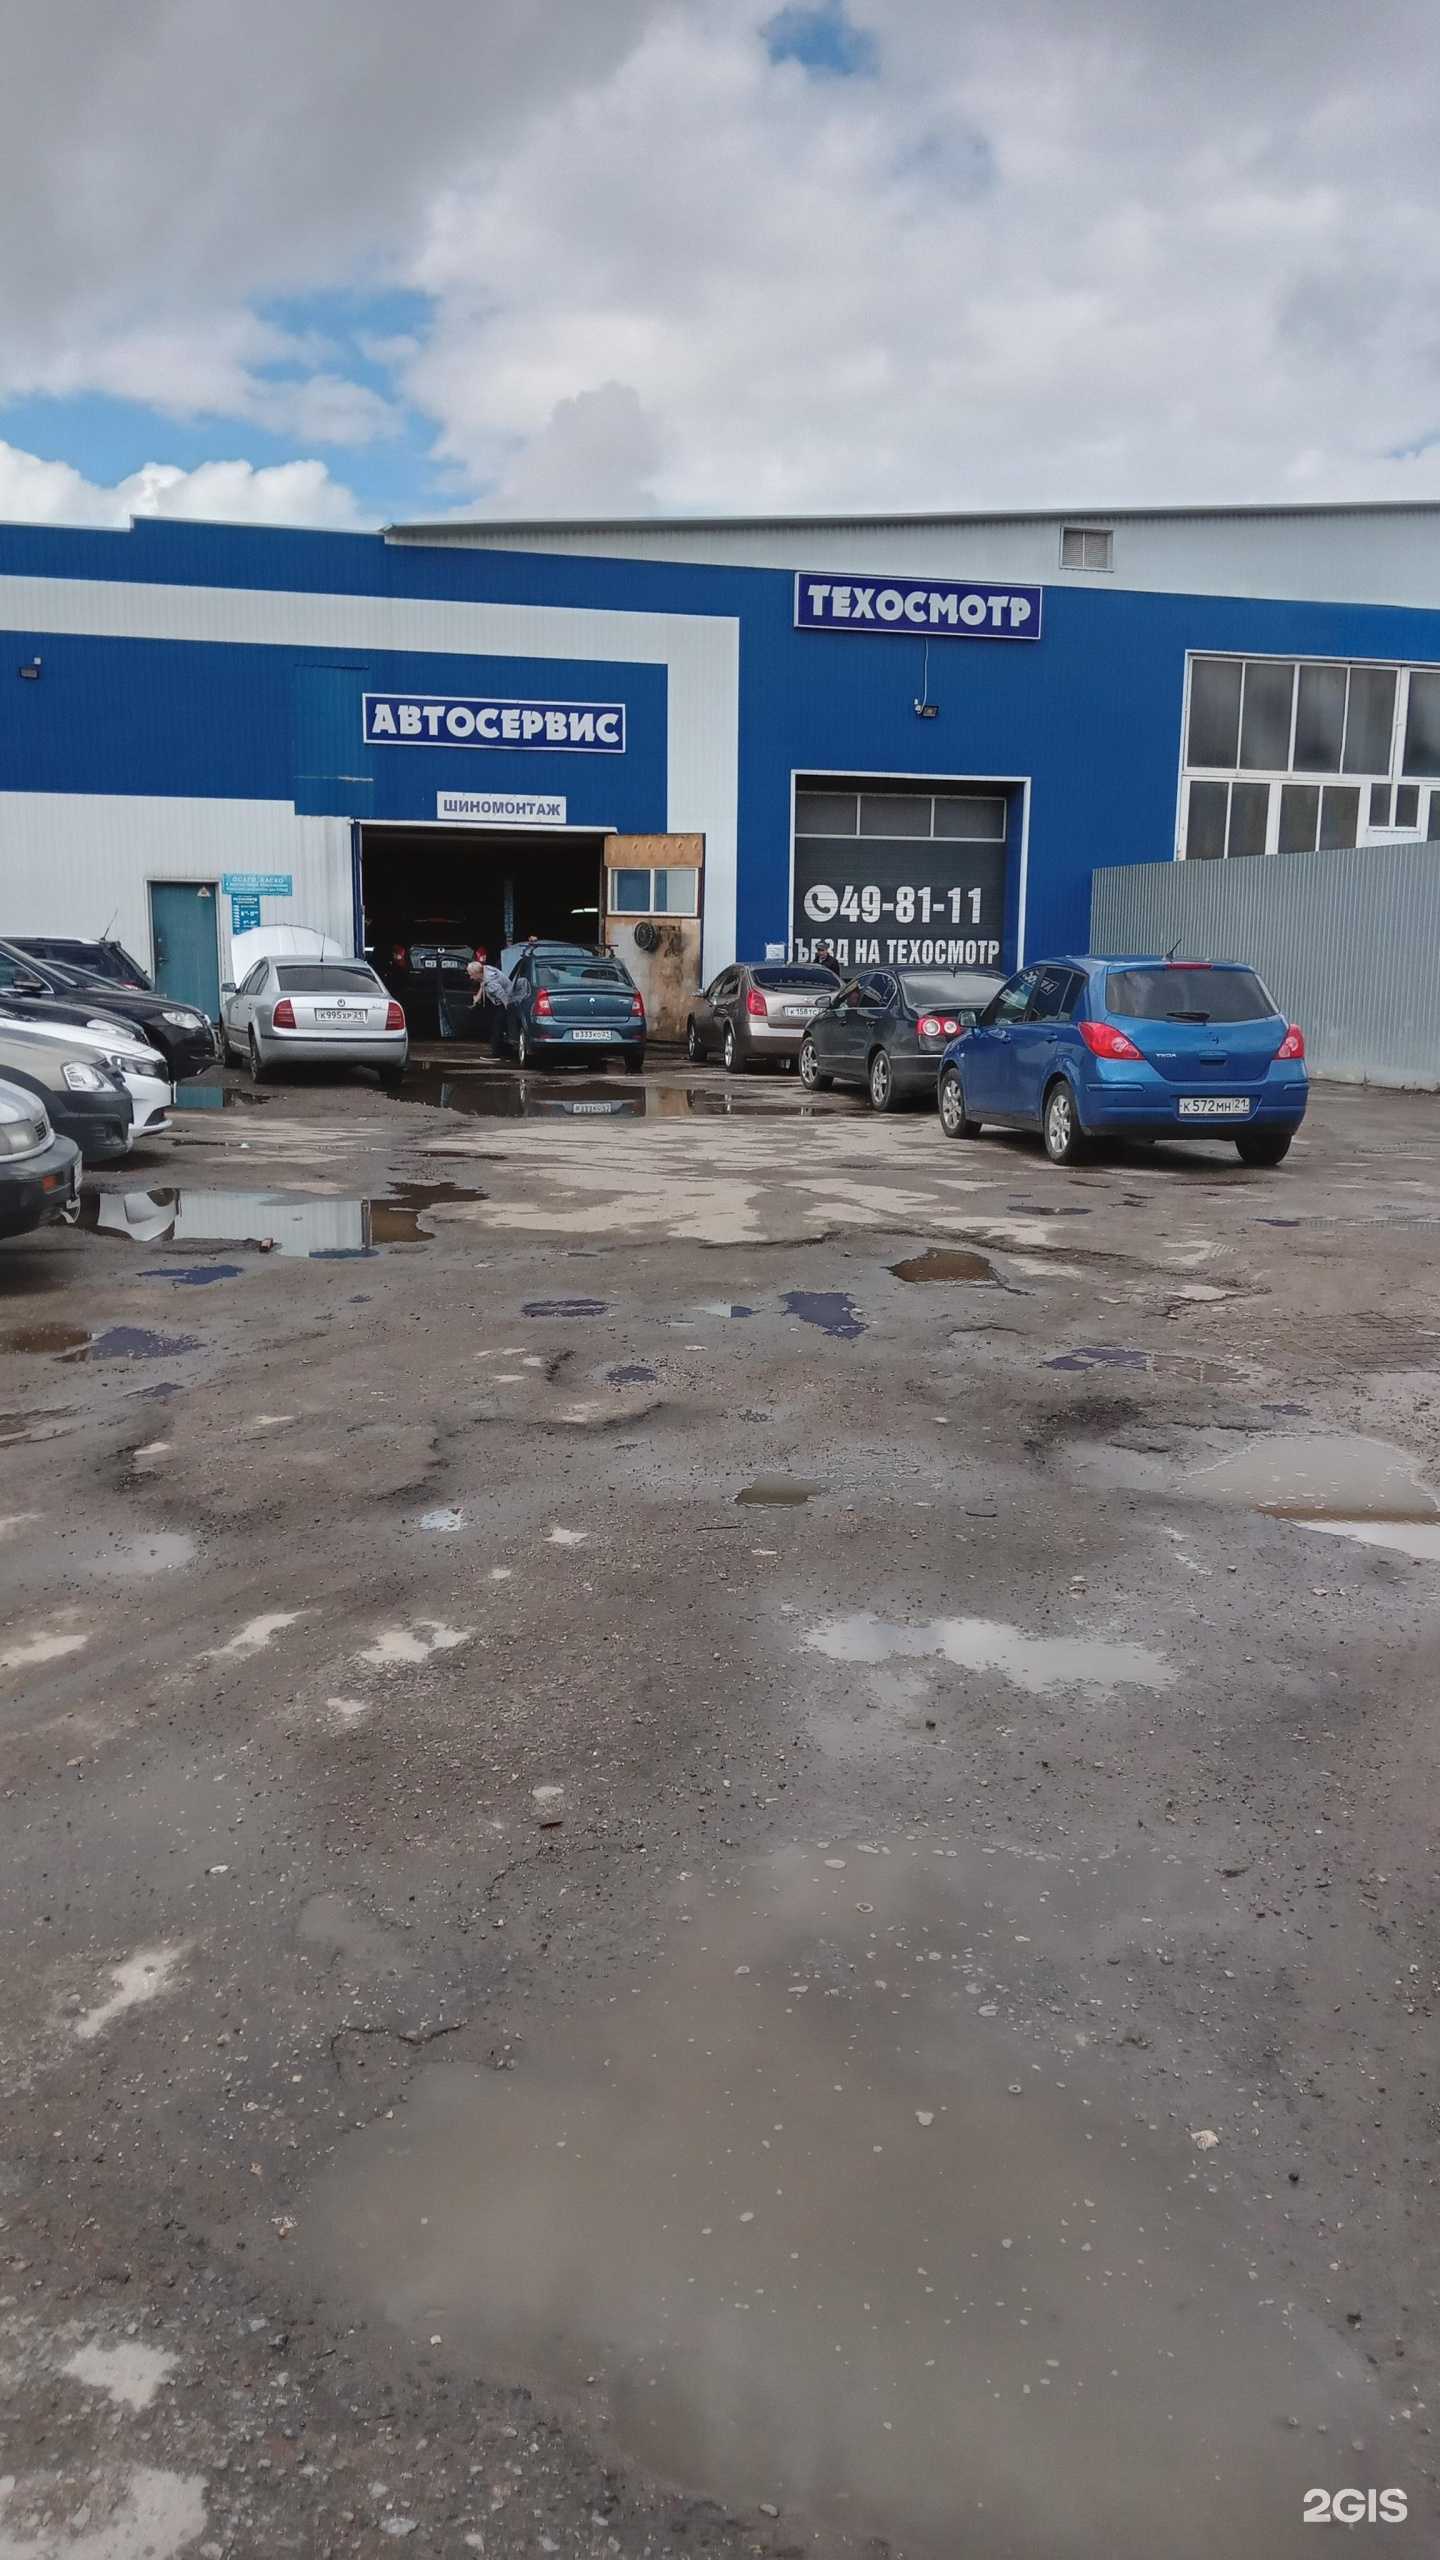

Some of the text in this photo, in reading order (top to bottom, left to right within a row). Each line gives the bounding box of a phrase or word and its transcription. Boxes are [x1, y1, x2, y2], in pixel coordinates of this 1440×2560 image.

[807, 583, 1032, 627] ТЕХОСМОТР
[371, 702, 621, 743] АВТОСЕРВИС
[443, 799, 561, 817] ШИНОМОНТАЖ
[839, 885, 982, 924] 49-81-11
[855, 938, 881, 964] НА
[886, 938, 1000, 965] ТЕХОСМОТР
